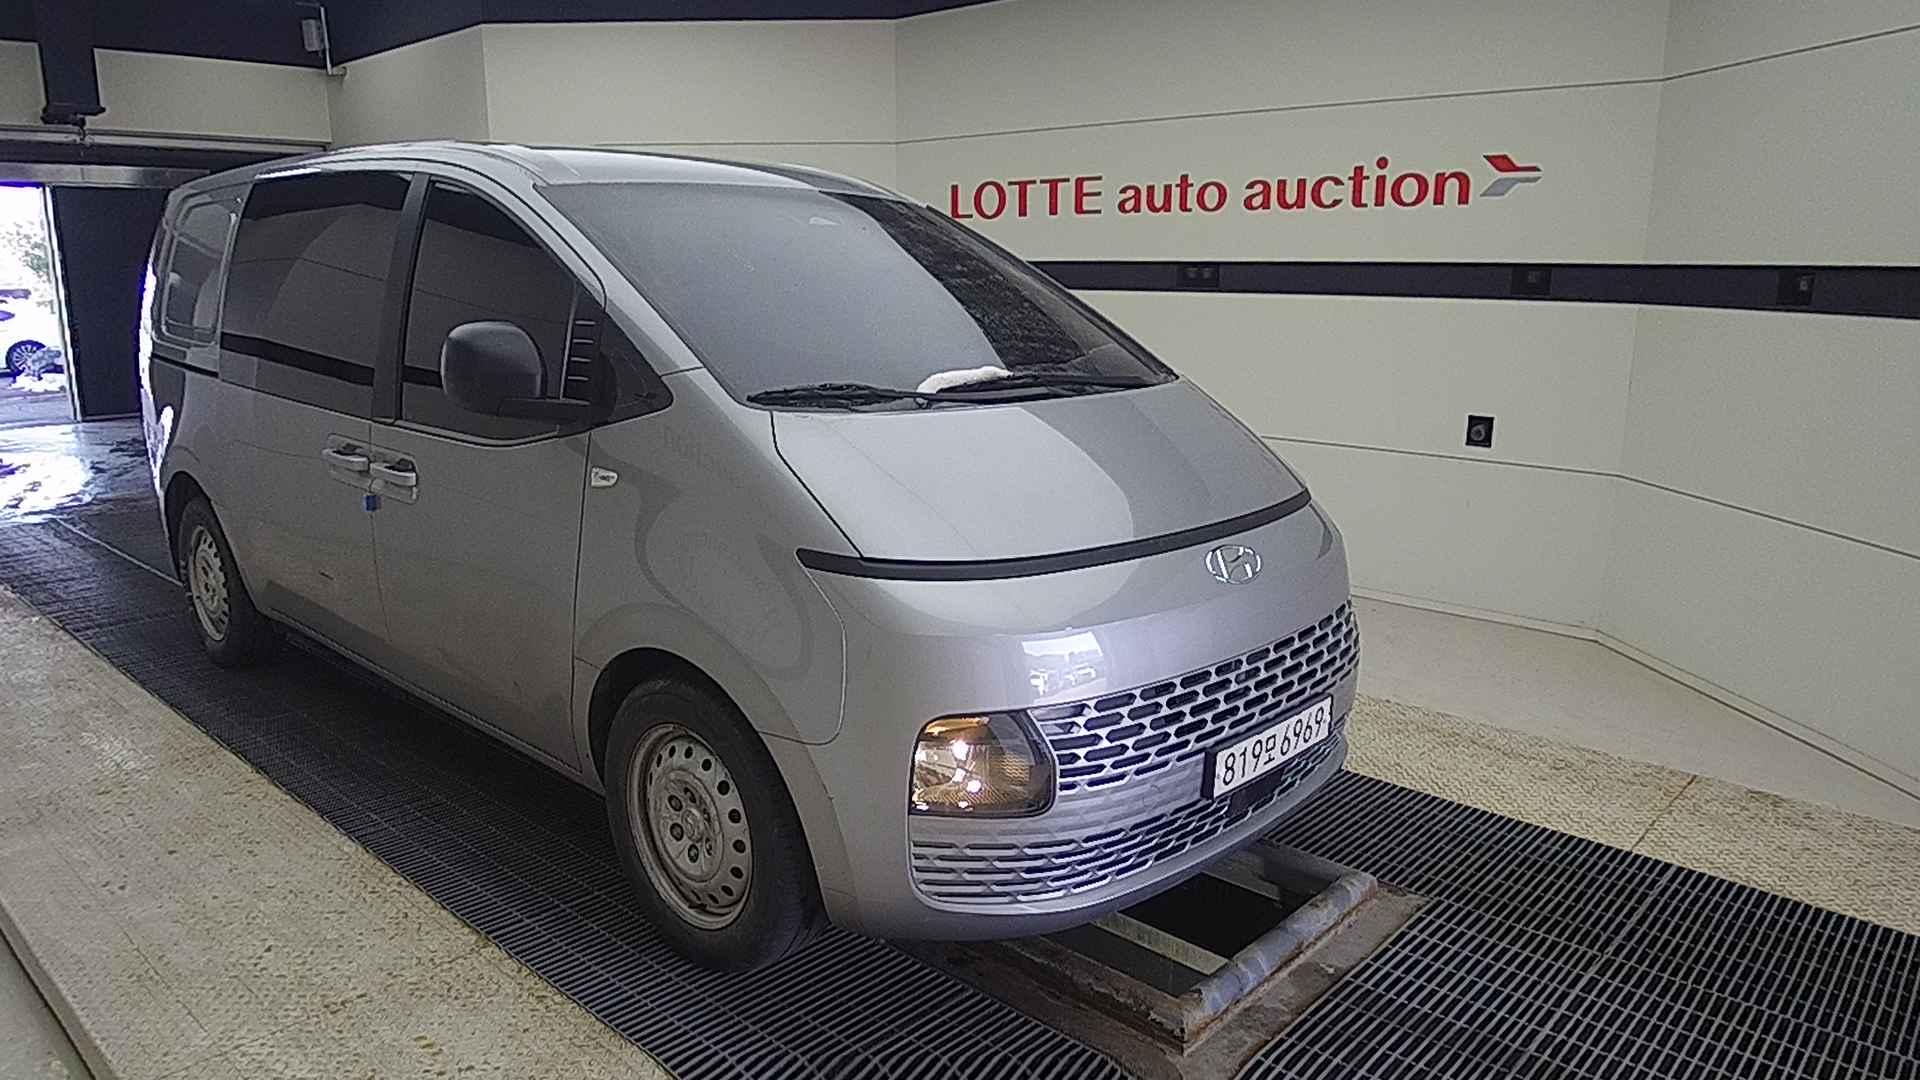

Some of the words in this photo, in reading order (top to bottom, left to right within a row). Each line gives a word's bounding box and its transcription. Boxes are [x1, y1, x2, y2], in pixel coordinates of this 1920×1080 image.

[950, 176, 1102, 220] LOTTE
[1118, 174, 1228, 214] auto
[1244, 156, 1472, 212] auction
[1222, 706, 1324, 786] 819모6969
